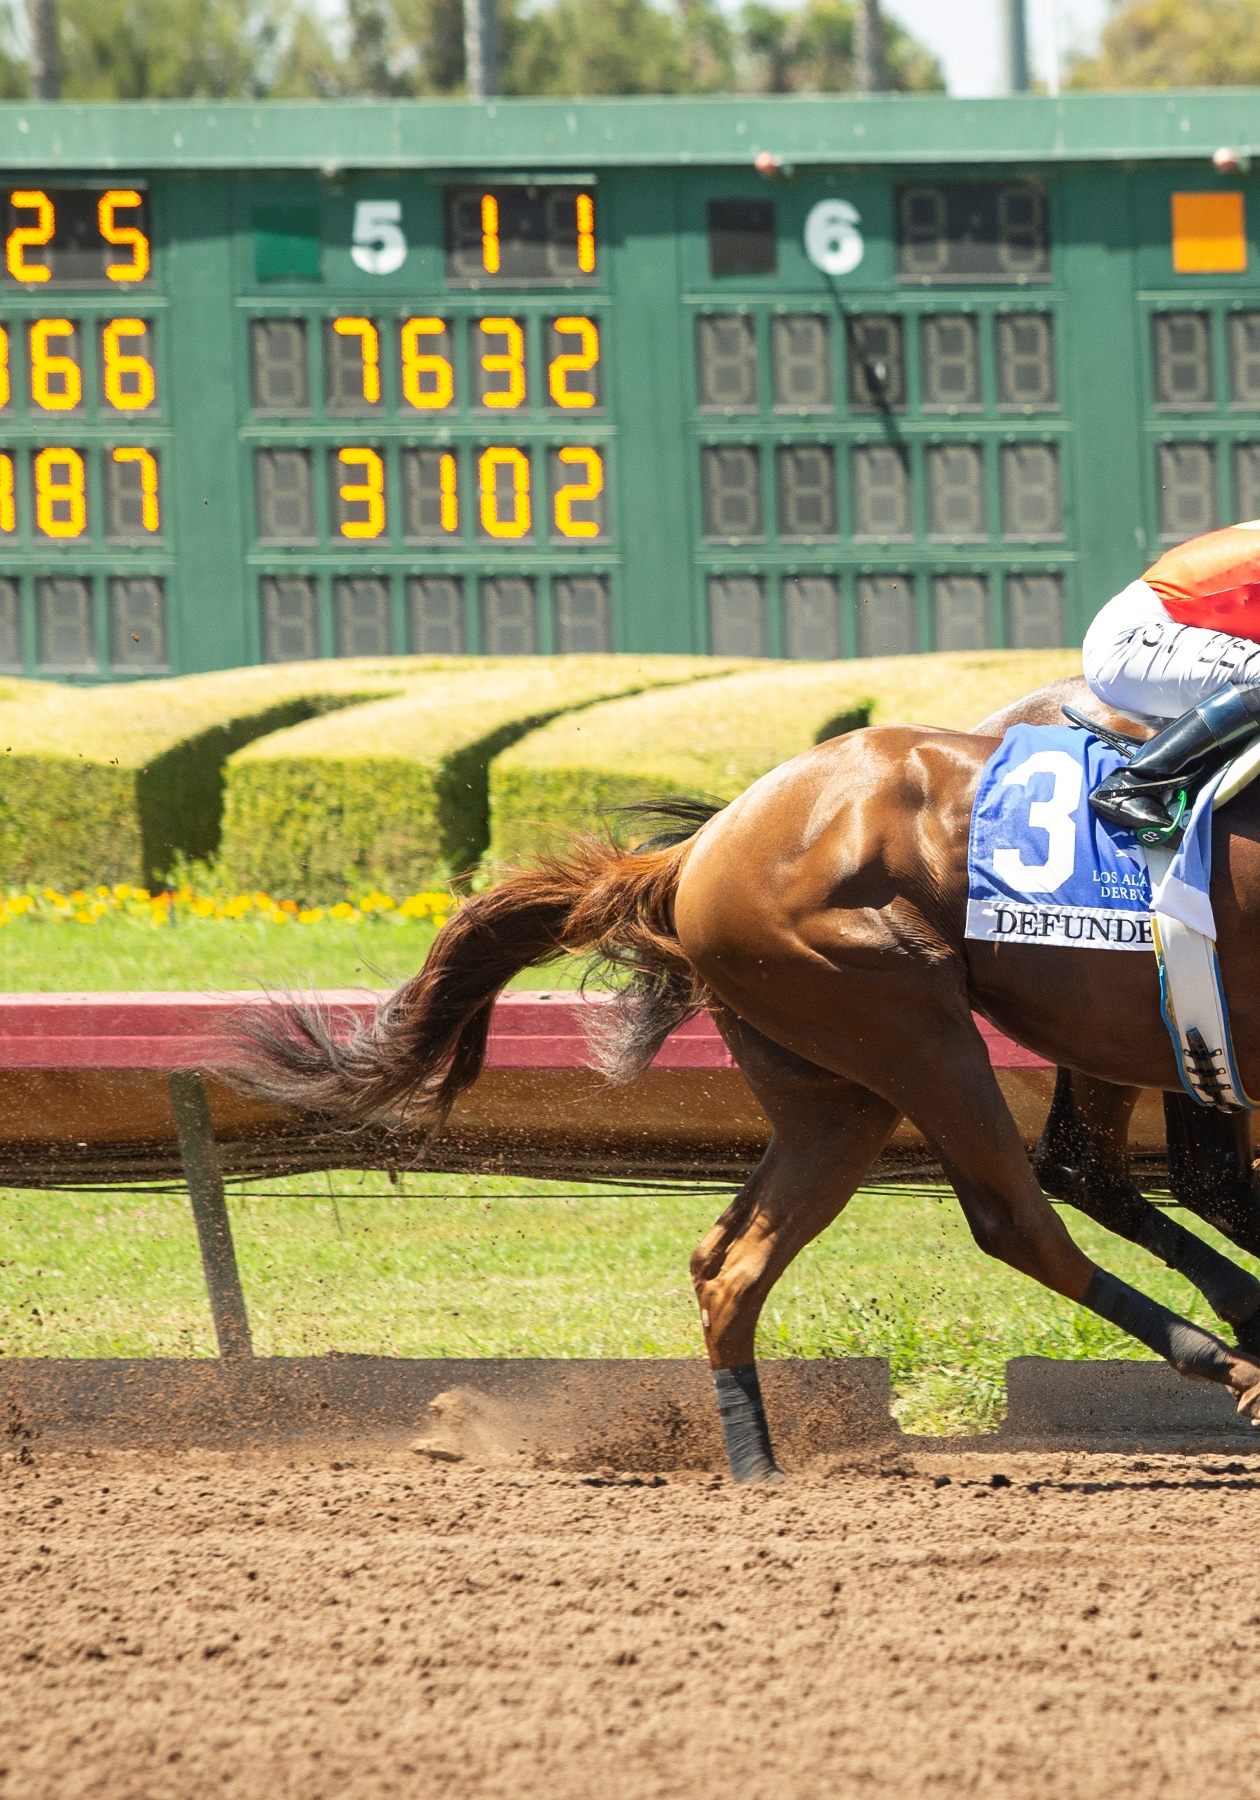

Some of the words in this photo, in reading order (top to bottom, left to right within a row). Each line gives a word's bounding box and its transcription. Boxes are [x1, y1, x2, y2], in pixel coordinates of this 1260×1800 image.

[351, 200, 408, 275] 5
[804, 199, 864, 275] 6
[0, 318, 155, 410] 66
[333, 317, 599, 409] 7632
[339, 447, 603, 538] 3102
[993, 750, 1083, 893] 3
[1093, 870, 1118, 884] LOS
[1121, 873, 1150, 888] ALA
[1101, 886, 1146, 901] DERBY
